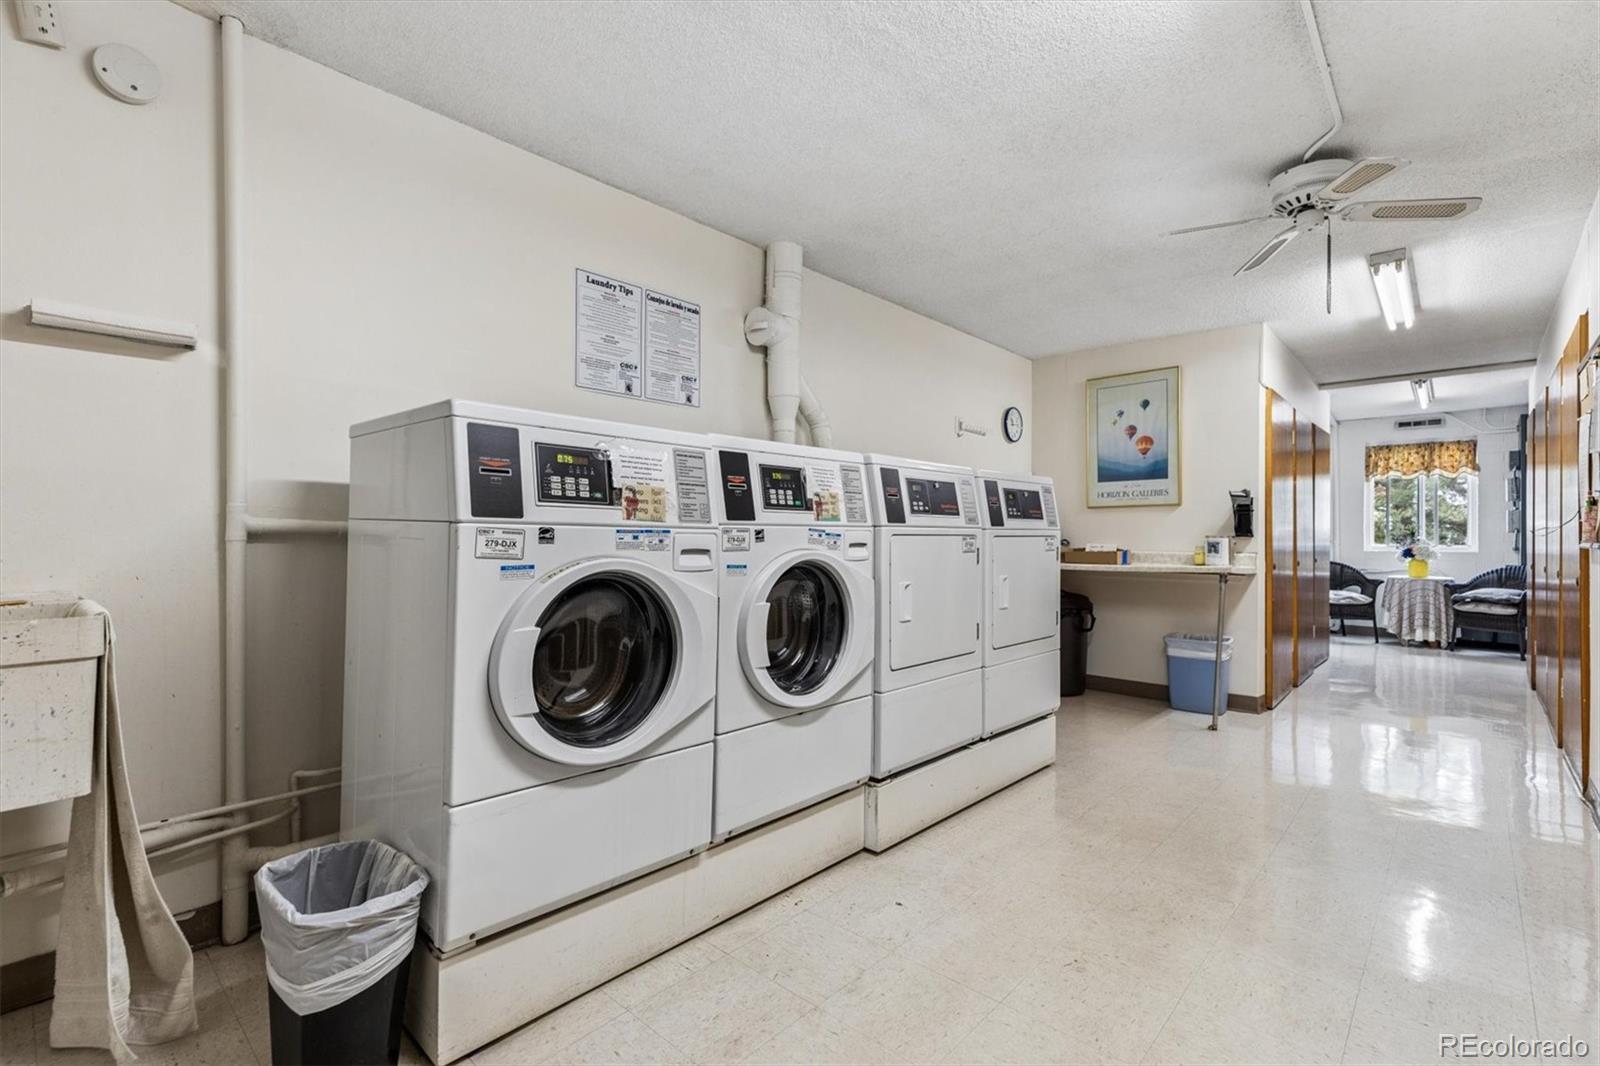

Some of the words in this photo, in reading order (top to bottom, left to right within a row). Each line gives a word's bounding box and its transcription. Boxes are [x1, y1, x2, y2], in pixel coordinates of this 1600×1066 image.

[586, 275, 617, 292] Laundry
[618, 284, 634, 296] Tips
[620, 362, 634, 370] CSC
[1097, 490, 1130, 499] HORIZON
[1131, 488, 1169, 497] GALLERIES
[485, 540, 518, 548] 279-DJX
